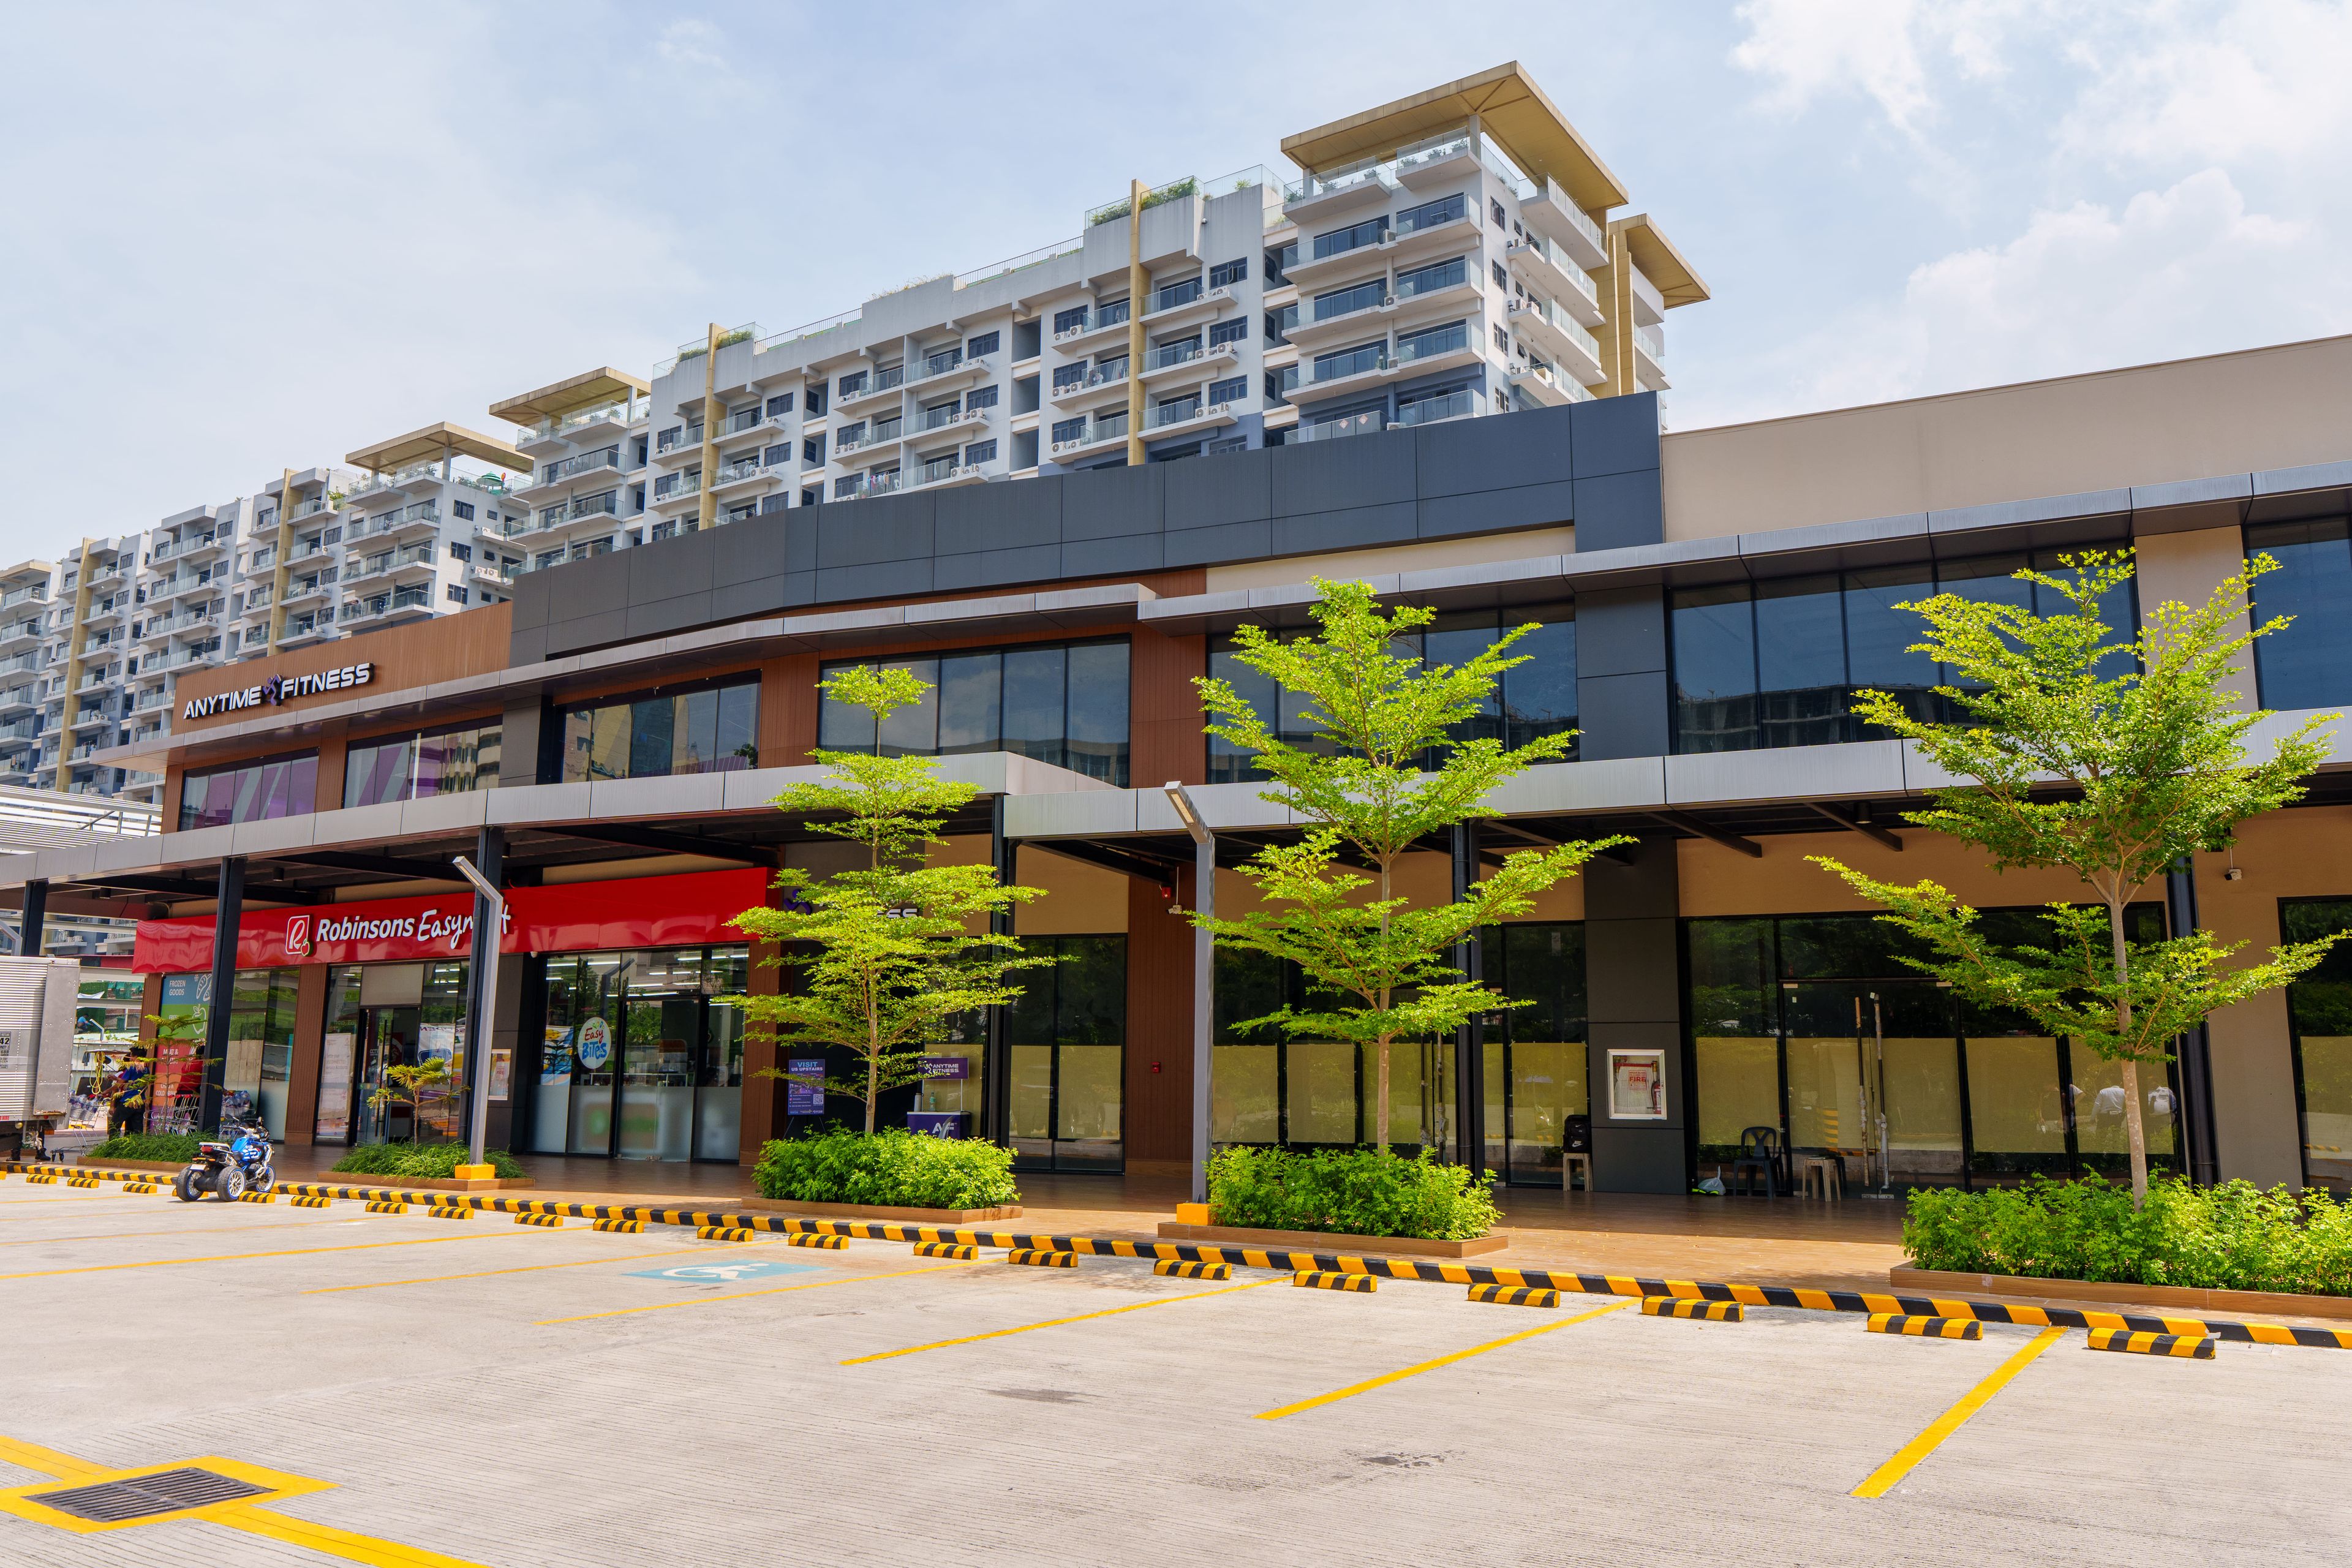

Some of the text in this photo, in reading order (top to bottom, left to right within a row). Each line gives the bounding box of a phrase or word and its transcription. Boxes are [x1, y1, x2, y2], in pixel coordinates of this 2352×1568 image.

[184, 662, 371, 719] ANYTIME FITNESS
[316, 904, 511, 949] Robinsons Easymt
[584, 1027, 604, 1044] Easy
